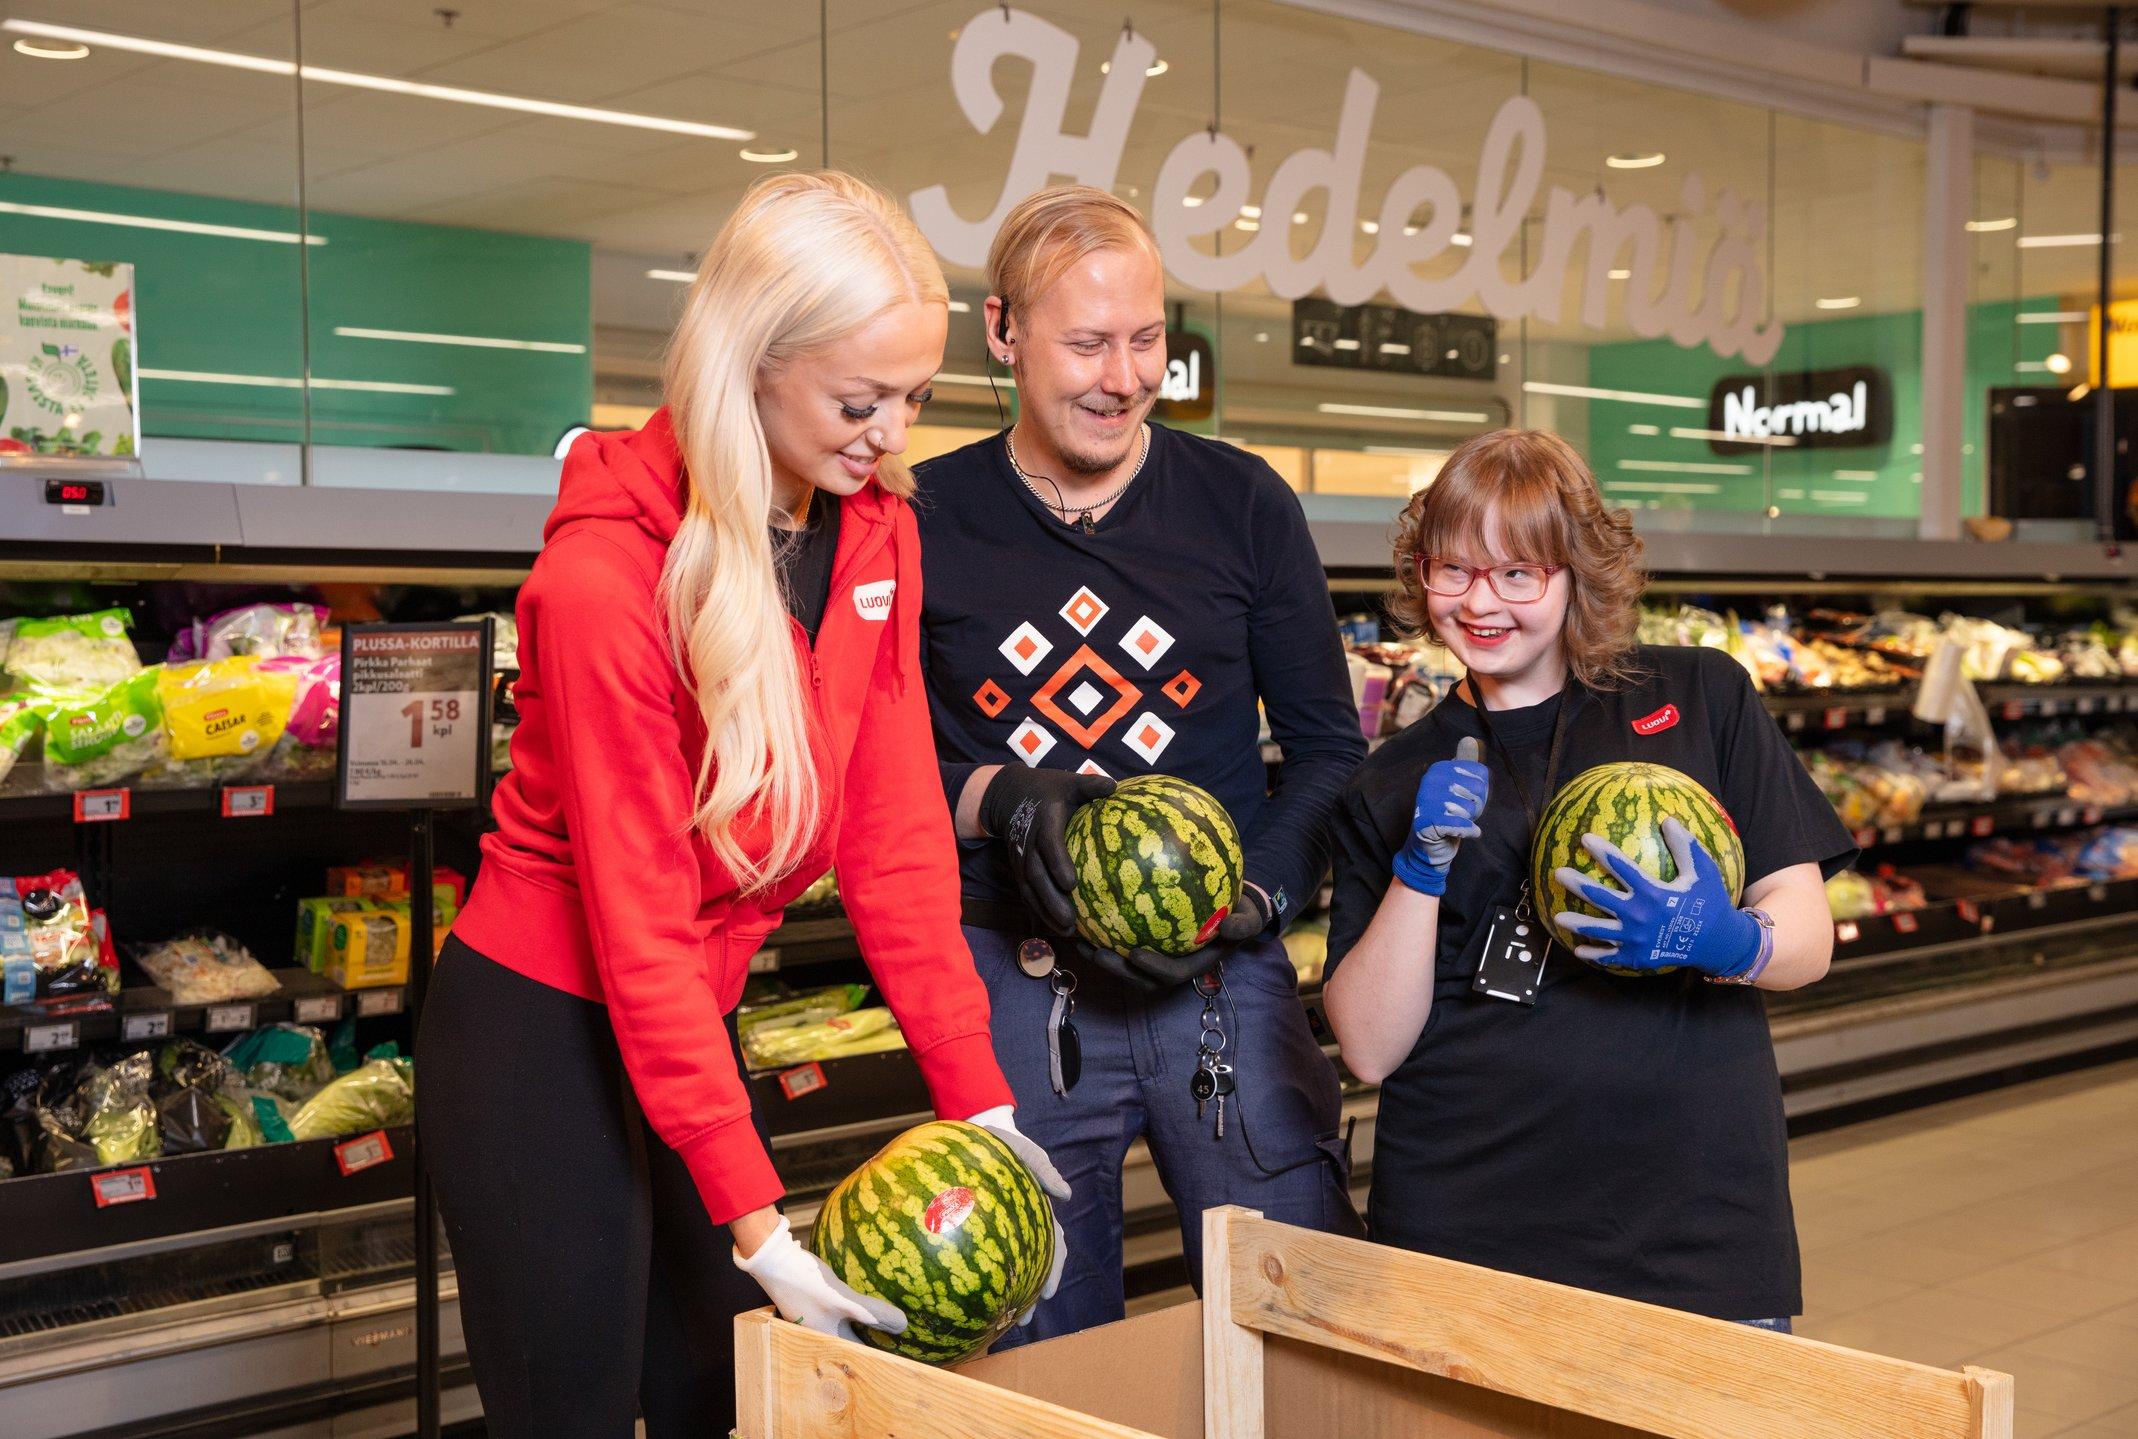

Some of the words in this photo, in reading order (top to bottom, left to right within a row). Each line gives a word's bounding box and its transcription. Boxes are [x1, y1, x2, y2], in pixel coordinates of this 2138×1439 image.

[910, 8, 1784, 367] Hedelmiä
[1724, 380, 1867, 441] Normal
[352, 635, 480, 651] PLUSSA-KORTILLA
[353, 657, 389, 668] Pirkka
[401, 699, 424, 748] 1
[431, 698, 460, 720] 58
[433, 724, 452, 738] kpl
[1197, 1085, 1210, 1095] 45
